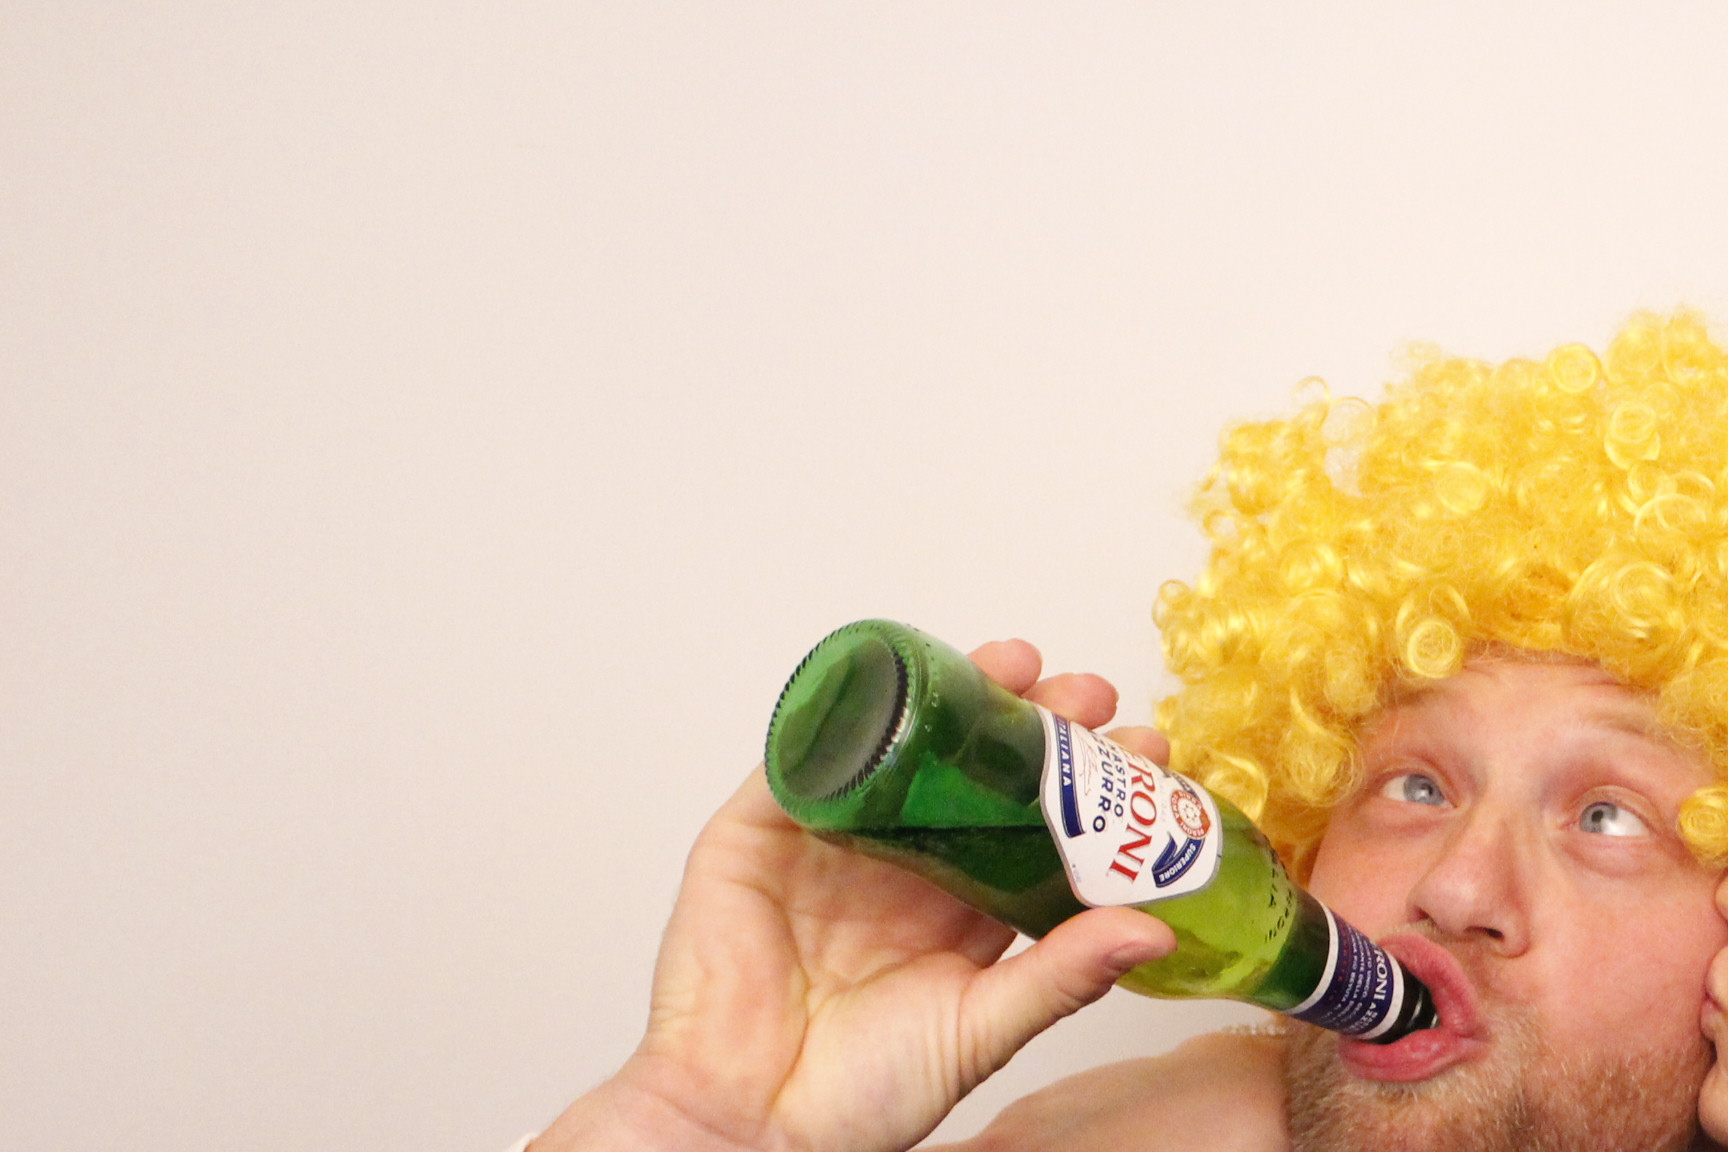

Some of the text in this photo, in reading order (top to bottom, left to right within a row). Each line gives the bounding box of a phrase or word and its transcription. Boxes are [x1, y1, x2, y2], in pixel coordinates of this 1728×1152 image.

[1092, 735, 1114, 833] ZURRO
[1109, 760, 1158, 885] RONI
[1158, 842, 1197, 883] SUPERIORE
[1373, 949, 1389, 1001] RONI
